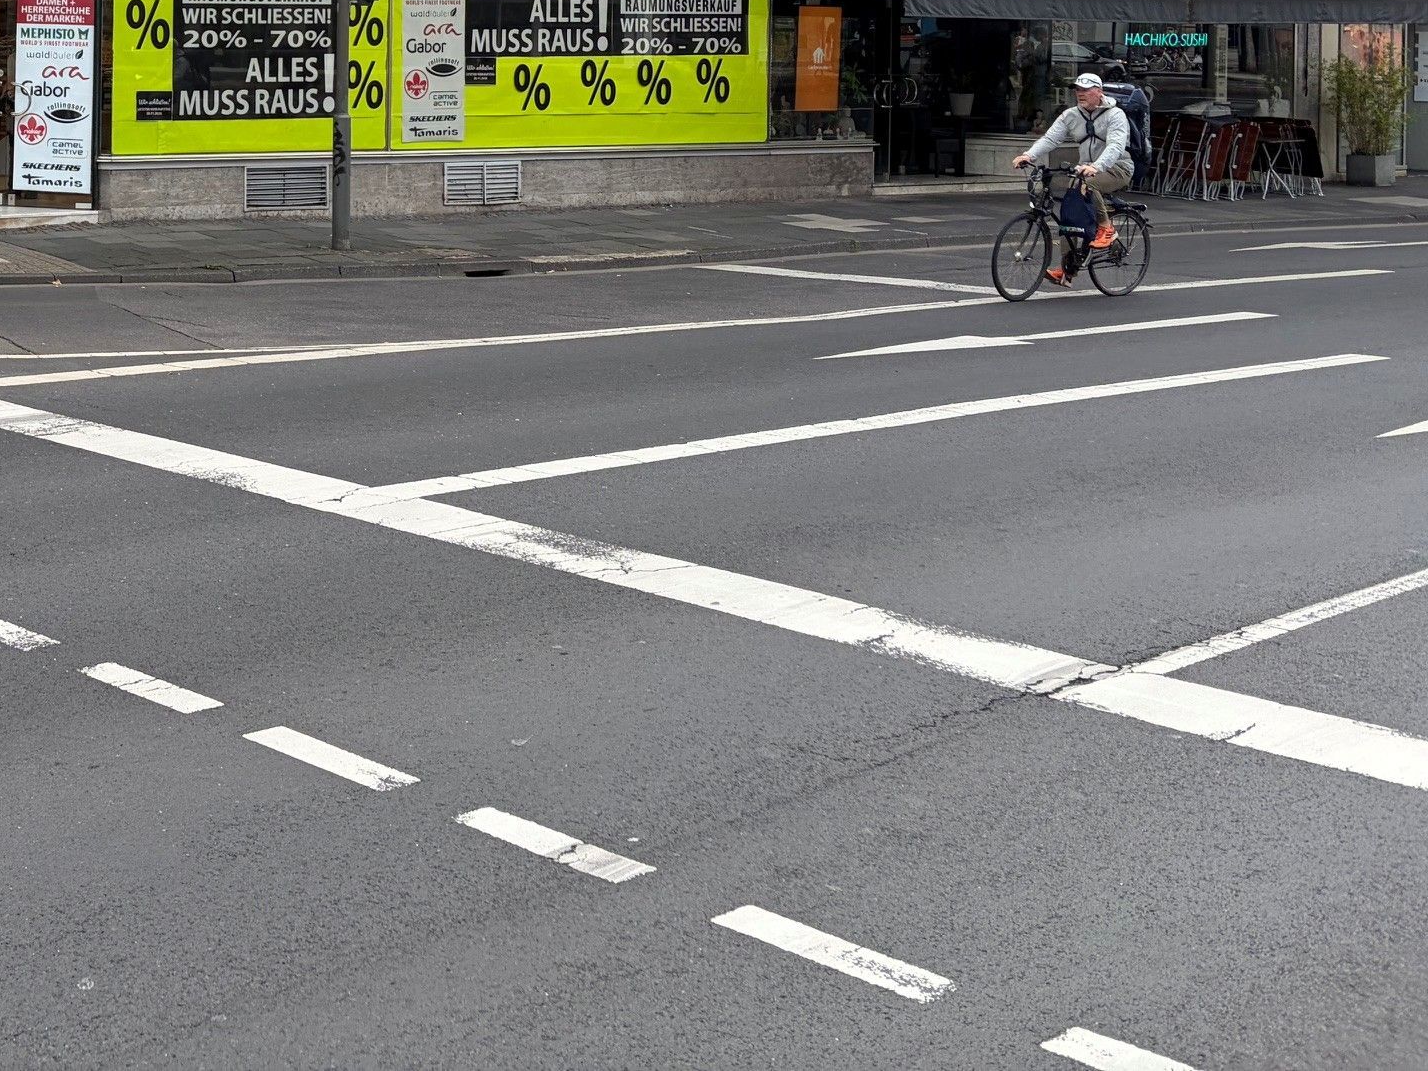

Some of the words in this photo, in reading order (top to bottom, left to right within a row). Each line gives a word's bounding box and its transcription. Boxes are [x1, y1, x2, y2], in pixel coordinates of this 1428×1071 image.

[21, 6, 91, 16] HERRENSCHUHE
[26, 14, 44, 23] DER
[45, 14, 85, 24] MARKEN:
[182, 8, 217, 25] WIR
[222, 7, 332, 25] SCHLIESSEN!
[423, 23, 462, 36] ara
[620, 18, 649, 33] WIR
[652, 17, 742, 33] SCHLIESSEN!
[20, 27, 75, 40] MEPHISTO
[183, 30, 247, 49] 20%
[271, 30, 332, 49] 70%
[471, 28, 533, 53] MUSS
[406, 38, 447, 54] Gabor
[621, 37, 672, 54] 20%
[692, 37, 742, 54] 70%
[42, 65, 90, 80] ara
[245, 57, 318, 83] ALLES
[20, 80, 71, 98] Gabor
[178, 89, 250, 116] MUSS
[409, 115, 457, 123] SKECHERS
[21, 162, 81, 172] SKECHERS
